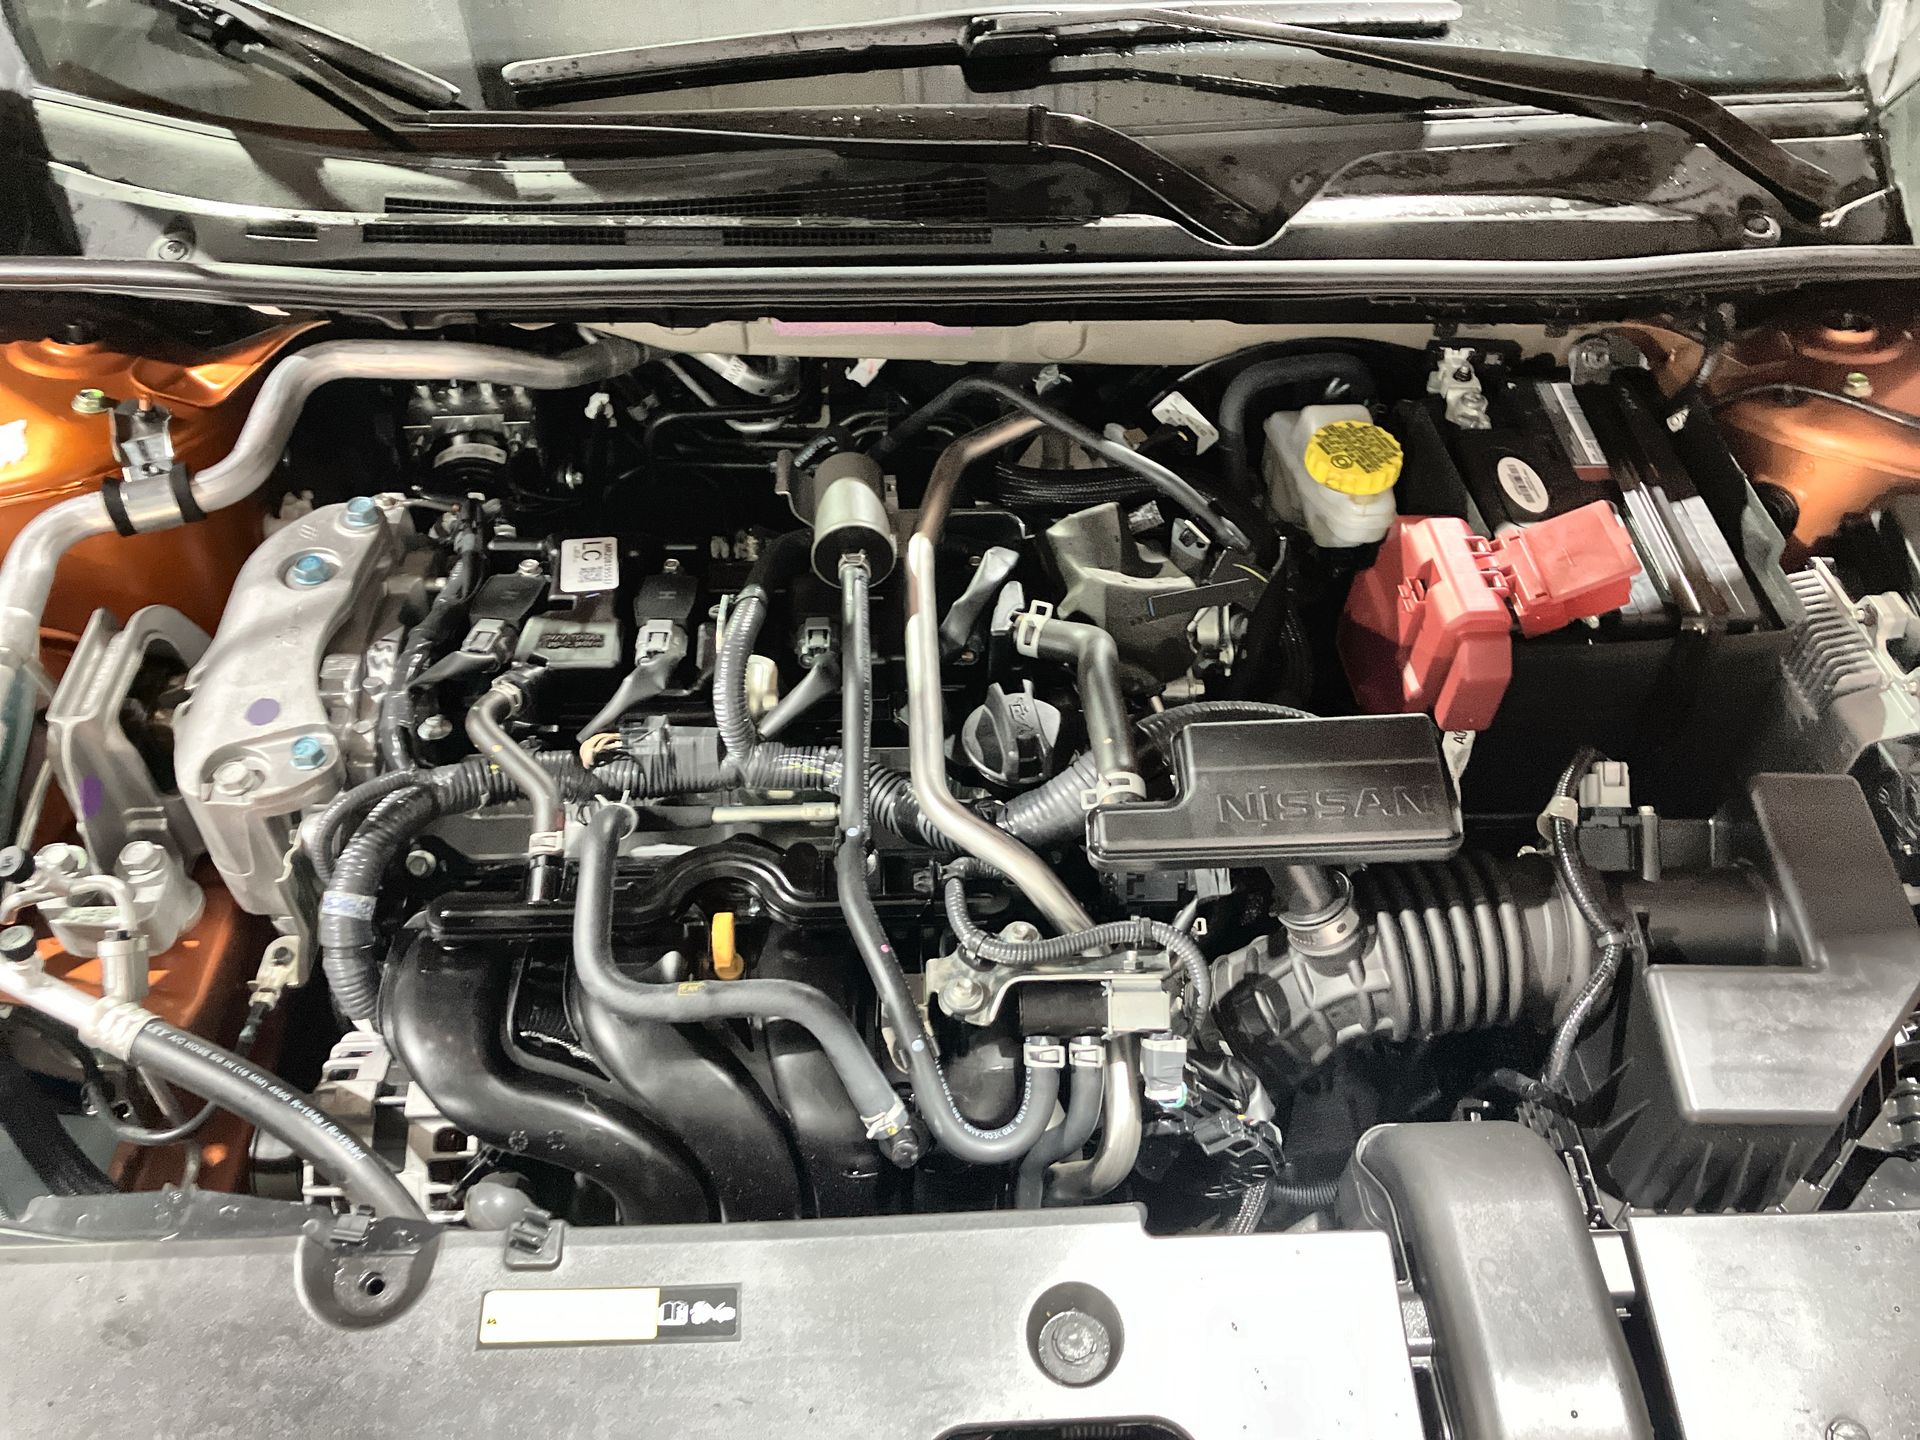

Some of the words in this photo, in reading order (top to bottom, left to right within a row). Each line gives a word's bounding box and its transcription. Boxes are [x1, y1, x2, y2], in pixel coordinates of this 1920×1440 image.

[581, 541, 602, 562] LC
[1217, 786, 1437, 825] NISSAN
[184, 1041, 210, 1057] HOSE
